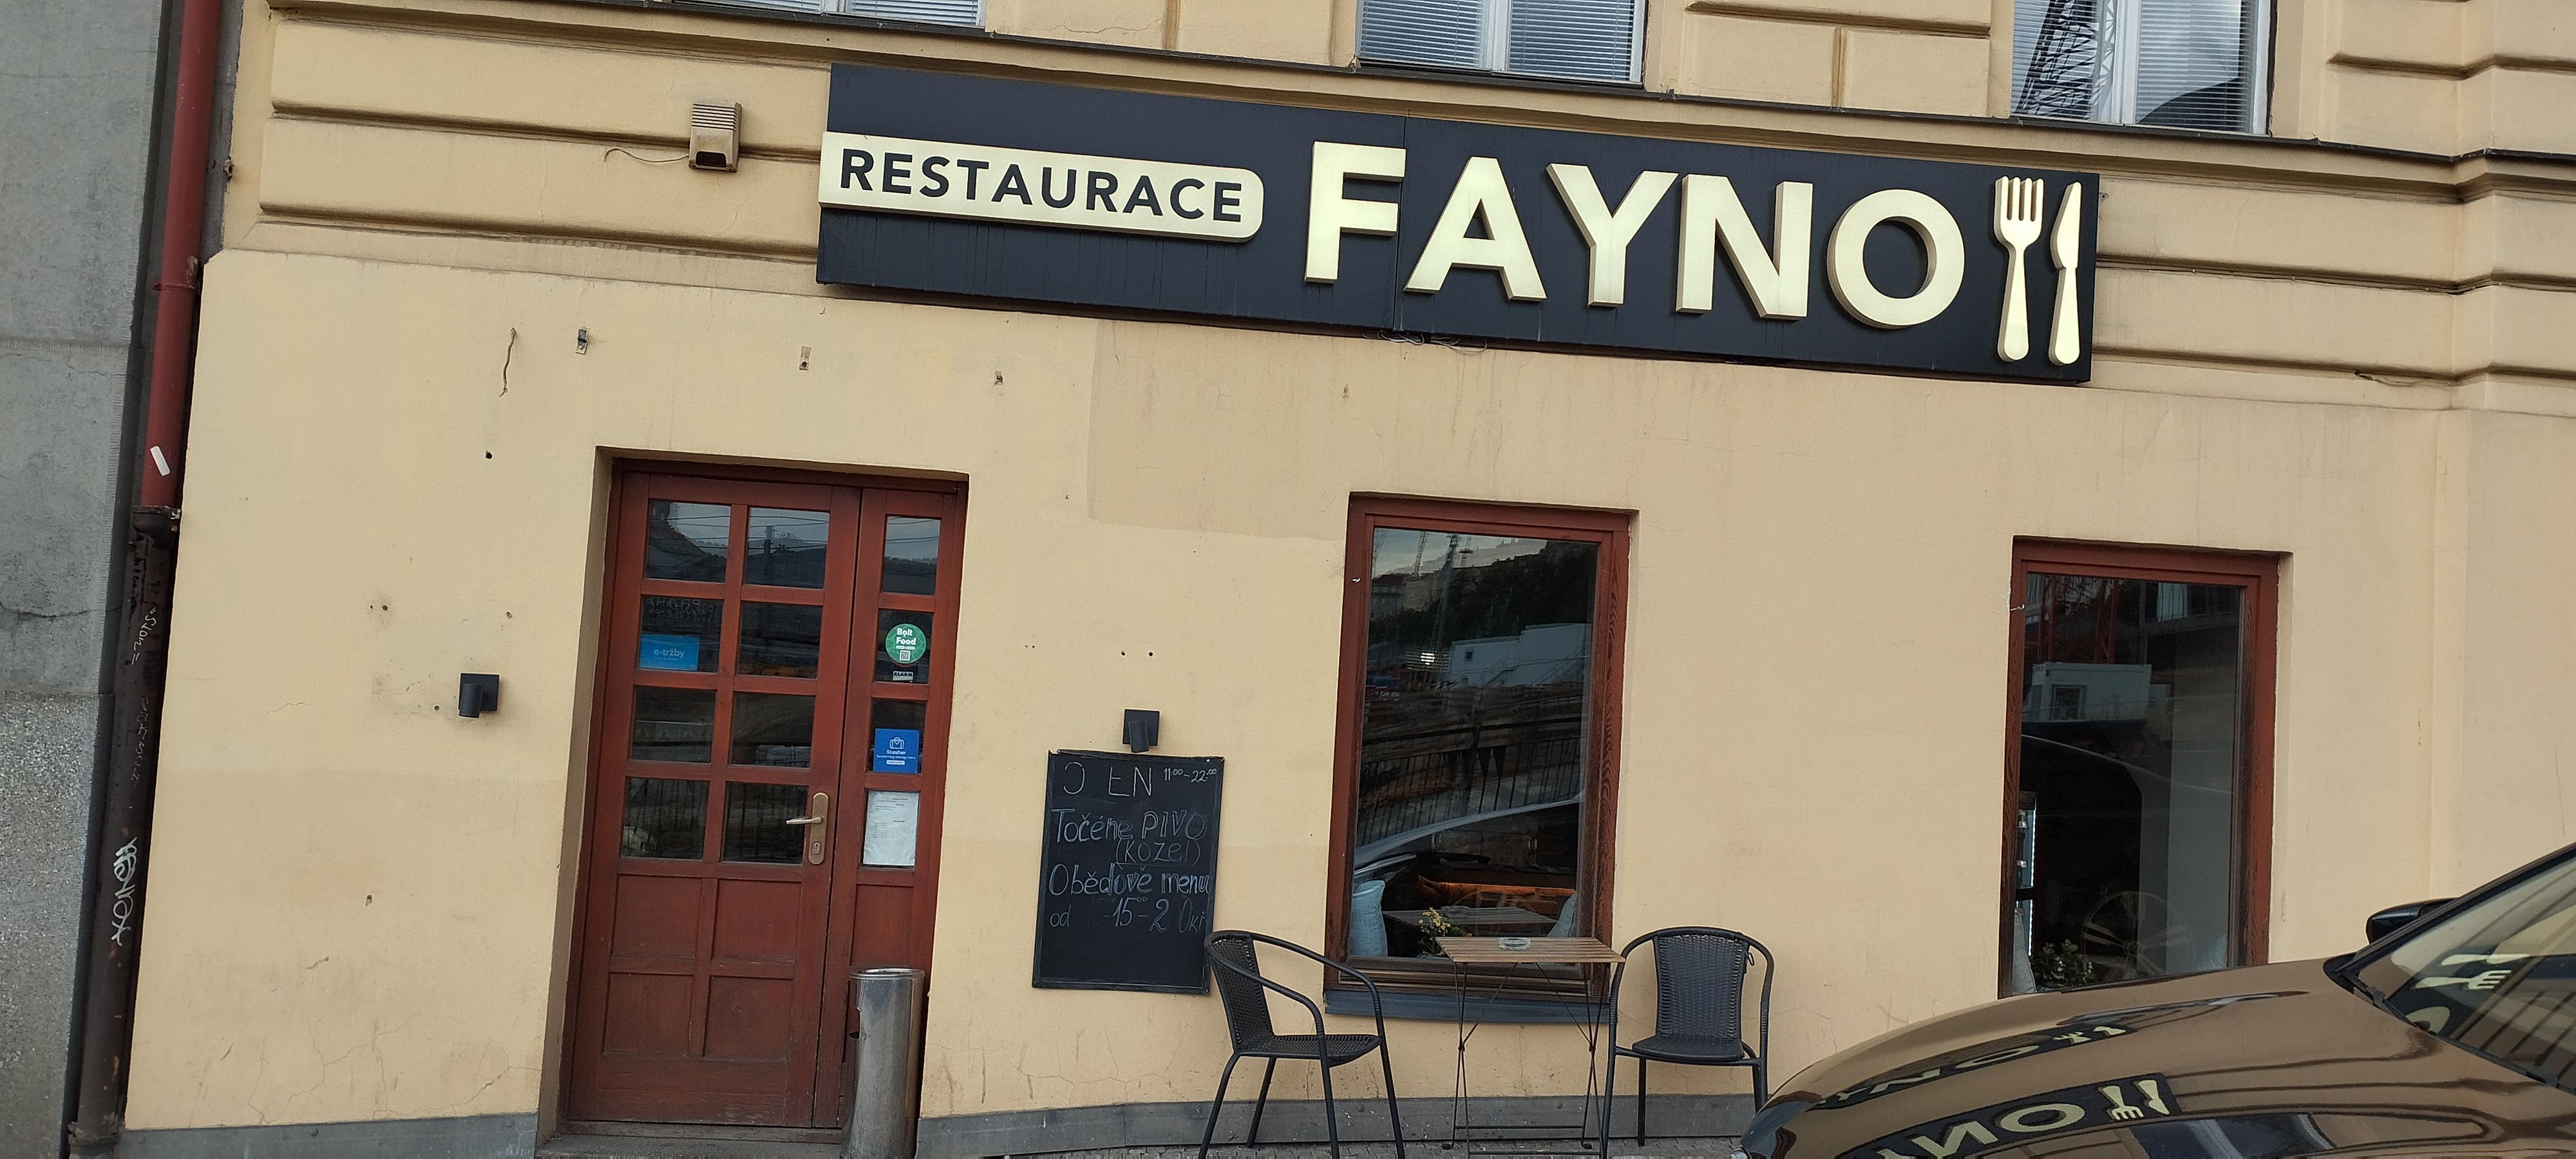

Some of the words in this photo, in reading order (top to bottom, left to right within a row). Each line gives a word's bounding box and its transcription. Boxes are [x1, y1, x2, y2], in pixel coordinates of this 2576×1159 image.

[839, 148, 1243, 223] RESTAURACE
[1304, 140, 1965, 329] FAYNO
[896, 637, 916, 645] Food
[897, 628, 913, 637] Bolt
[654, 648, 685, 659] e-tržby
[1142, 810, 1207, 840] PIVO
[1161, 873, 1209, 894] menu
[1050, 905, 1072, 927] od
